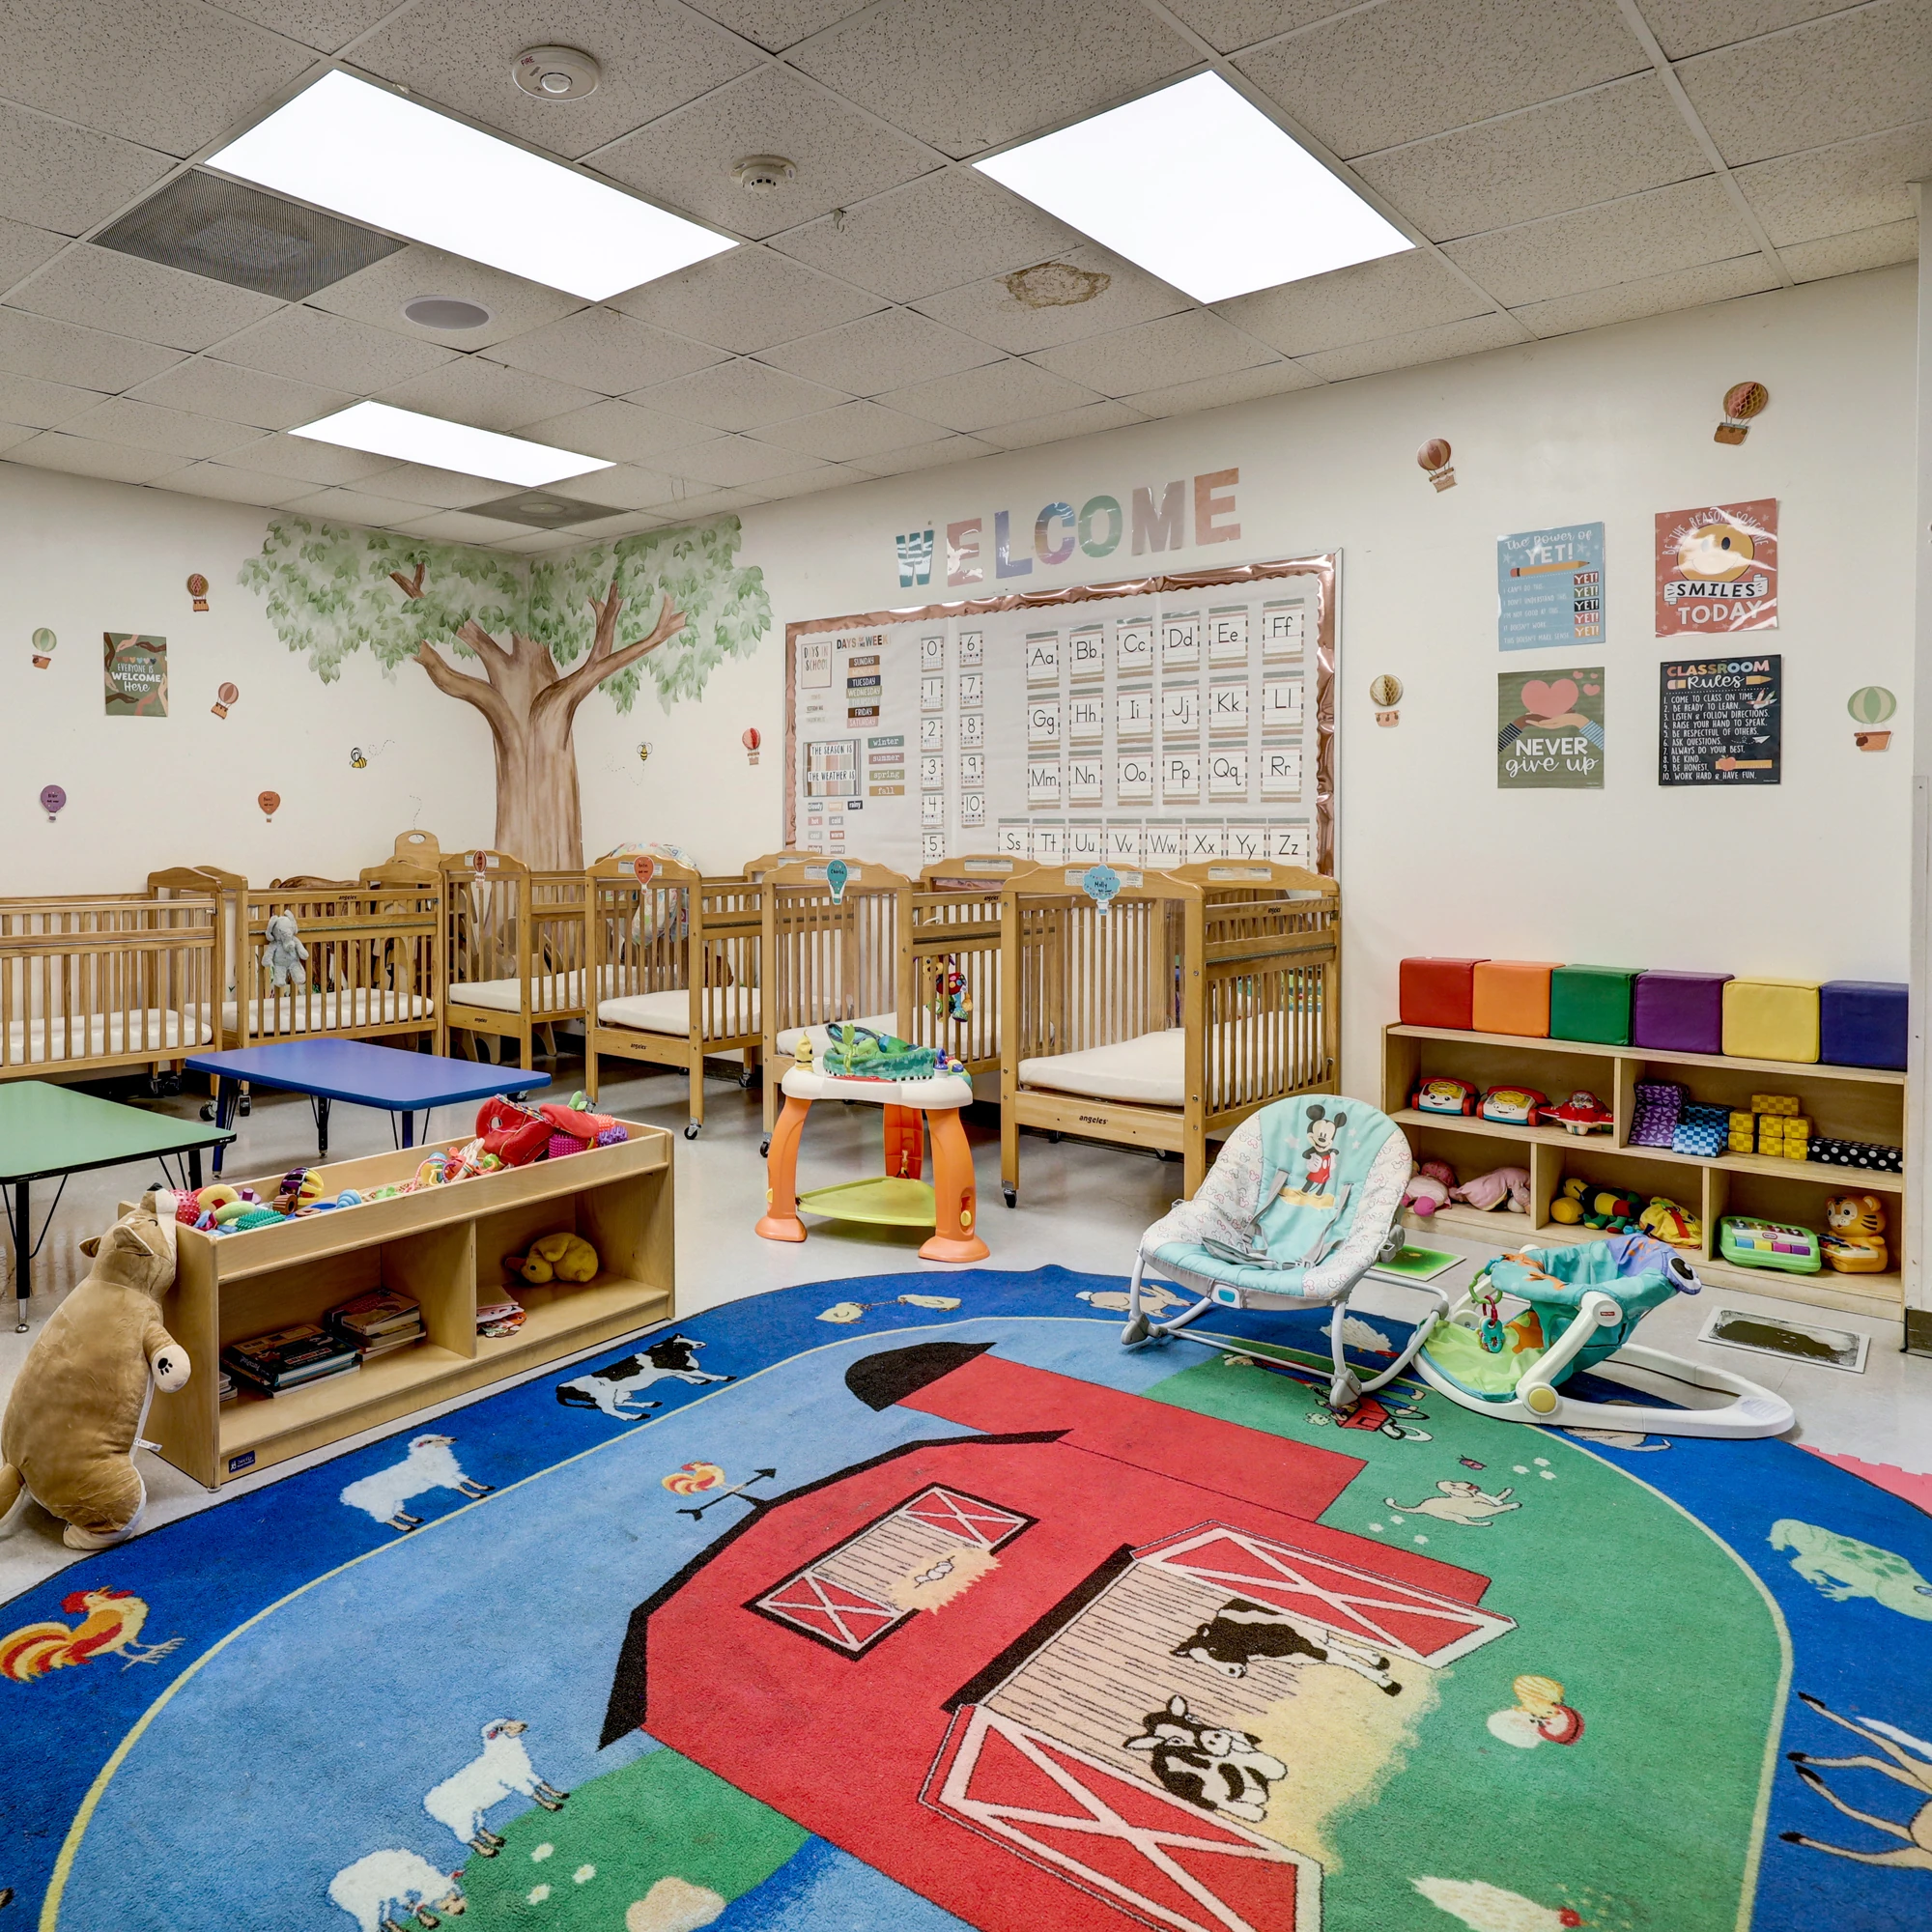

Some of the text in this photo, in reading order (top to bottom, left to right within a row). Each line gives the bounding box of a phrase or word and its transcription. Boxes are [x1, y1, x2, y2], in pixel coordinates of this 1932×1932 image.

[895, 468, 1240, 588] WELCOME
[1505, 537, 1529, 551] The
[1578, 530, 1592, 541] of
[1525, 542, 1573, 565] YET!
[1575, 573, 1599, 584] YET!
[1575, 585, 1599, 598] YET!
[1677, 583, 1755, 597] SMILES
[1575, 599, 1599, 611] YET!
[1575, 612, 1599, 623] YET!
[1678, 600, 1762, 625] TODAY
[1575, 625, 1599, 637] YET!
[837, 635, 888, 649] DAYS WEEK
[967, 636, 975, 651] 6
[1032, 616, 1293, 666] Aa Bb Cc Dd Ee Ff
[927, 640, 937, 656] 0
[117, 663, 146, 673] EVERYONE
[854, 658, 874, 667] SUNDAY
[1667, 660, 1770, 676] CLASSROOM
[111, 671, 161, 683] WELCOME
[852, 677, 875, 687] TUESDAY
[1688, 674, 1745, 690] Rules
[124, 681, 151, 693] Here
[967, 677, 975, 693] 7
[848, 688, 880, 697] WEDNESDAY
[1703, 694, 1722, 702] CLASS
[855, 708, 872, 717] FRIDAY
[1033, 689, 1292, 734] Gg Hh Ii Jj Kk Ll
[1685, 703, 1704, 712] READY
[1719, 701, 1741, 710] LEARN.
[1703, 711, 1728, 720] FOLLOW
[1731, 709, 1770, 719] DIRECTIONS.
[849, 718, 875, 727] SATURDAY
[968, 718, 976, 733] 8
[1746, 718, 1768, 726] SPEAK.
[928, 721, 935, 737] 2
[1672, 729, 1680, 738] BE
[1683, 728, 1719, 737] RESPECTFUL
[873, 737, 899, 747] winter
[1516, 737, 1588, 756] NEVER
[1672, 738, 1684, 747] ASK
[1687, 737, 1722, 746] QUESTIONS.
[811, 745, 852, 755] THE SEASON IS
[1730, 745, 1746, 753] BEST.
[873, 753, 899, 762] summer
[1684, 754, 1701, 763] KIND.
[928, 759, 936, 775] 3
[968, 757, 977, 773] 9
[1505, 756, 1600, 778] give up
[809, 770, 855, 781] THE WEATHER IS
[873, 771, 900, 781] spring
[1032, 756, 1291, 788] Mm Nn Oo Pp Qq Rr
[878, 786, 895, 795] fall
[928, 797, 936, 811] 4
[966, 796, 980, 811] 10
[929, 837, 938, 852] 5
[1007, 833, 1298, 860] Ss Tt Uu Vv Ww Xx Yy Zz
[1079, 1115, 1107, 1124] angeles
